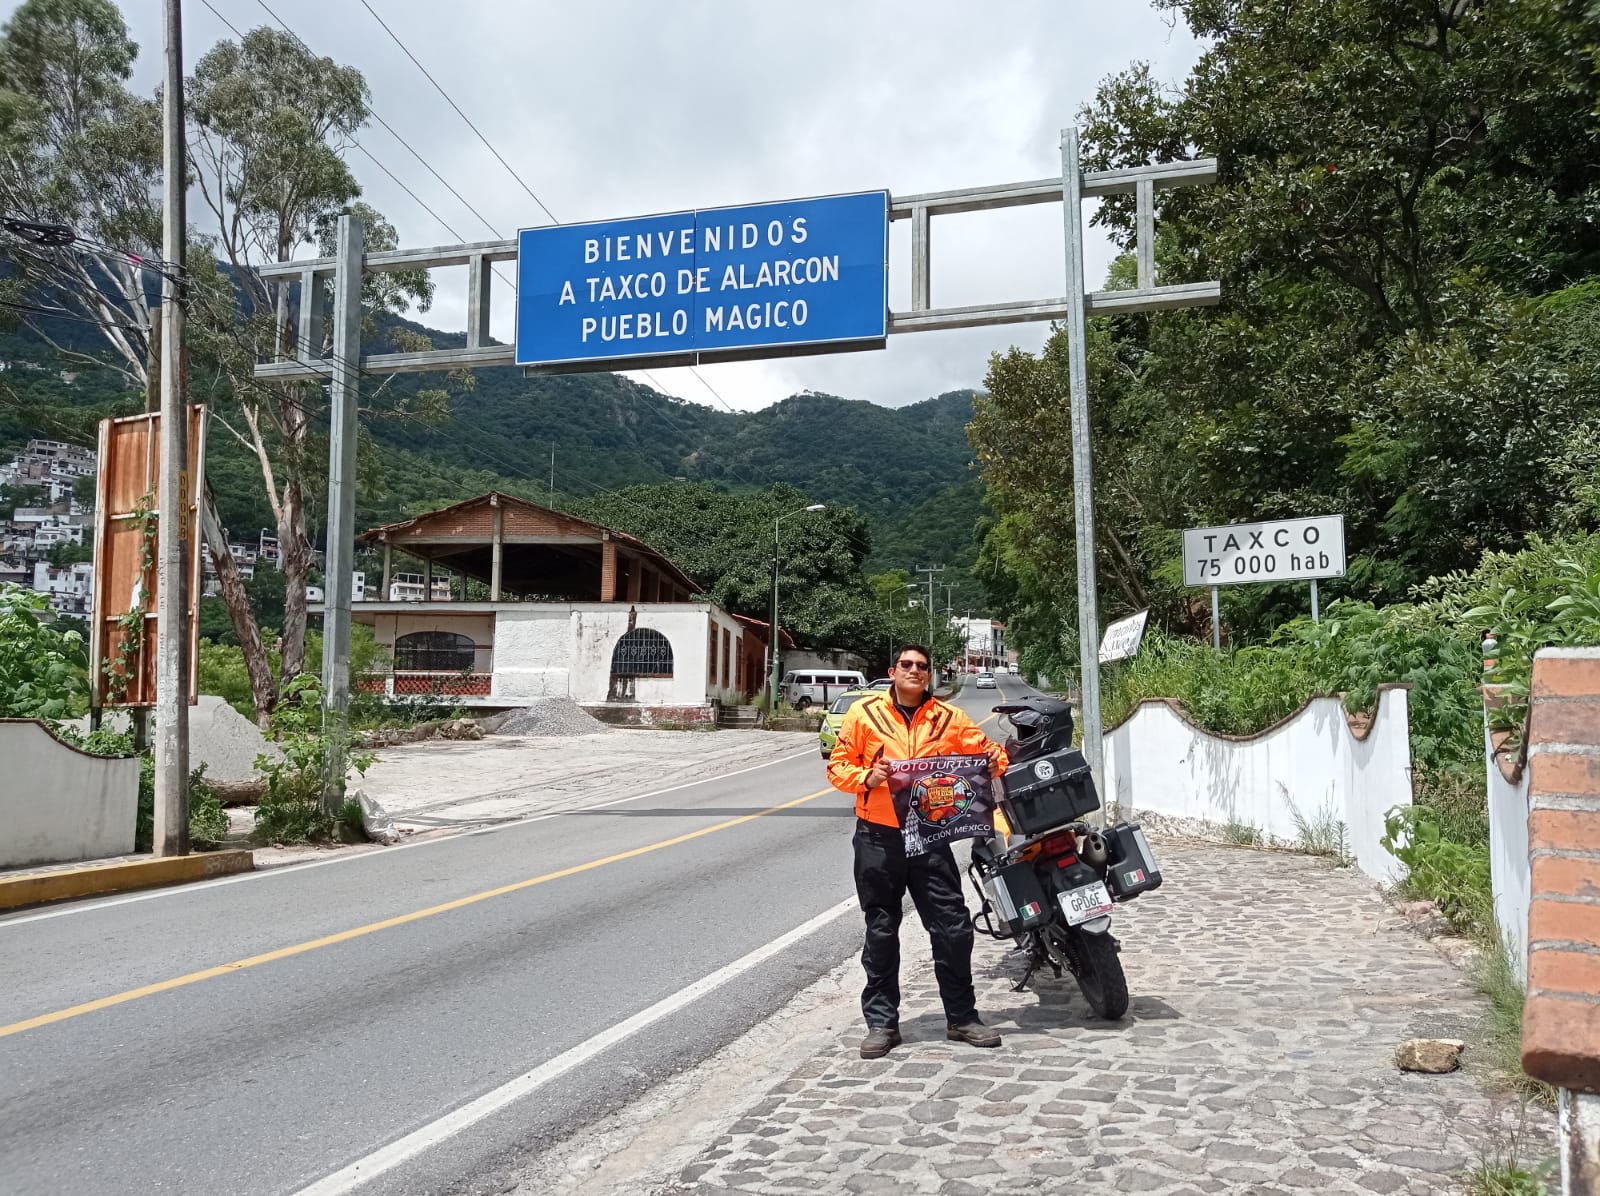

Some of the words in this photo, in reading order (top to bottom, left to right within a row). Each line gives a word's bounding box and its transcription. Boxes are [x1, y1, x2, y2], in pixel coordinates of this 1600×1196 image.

[585, 217, 808, 264] BIENVENIDOS
[559, 280, 576, 305] A
[587, 271, 665, 303] TAXCO
[677, 267, 711, 294] DE
[720, 255, 839, 291] ALARCON
[582, 309, 688, 342] PUEBLO
[705, 299, 808, 333] MAGICO
[1203, 526, 1320, 553] TAXCO
[1197, 558, 1221, 577] 75
[1234, 554, 1276, 575] 000
[1291, 551, 1330, 571] hab
[891, 758, 988, 773] MOTOTURISTA
[1071, 892, 1103, 912] GPD6E
